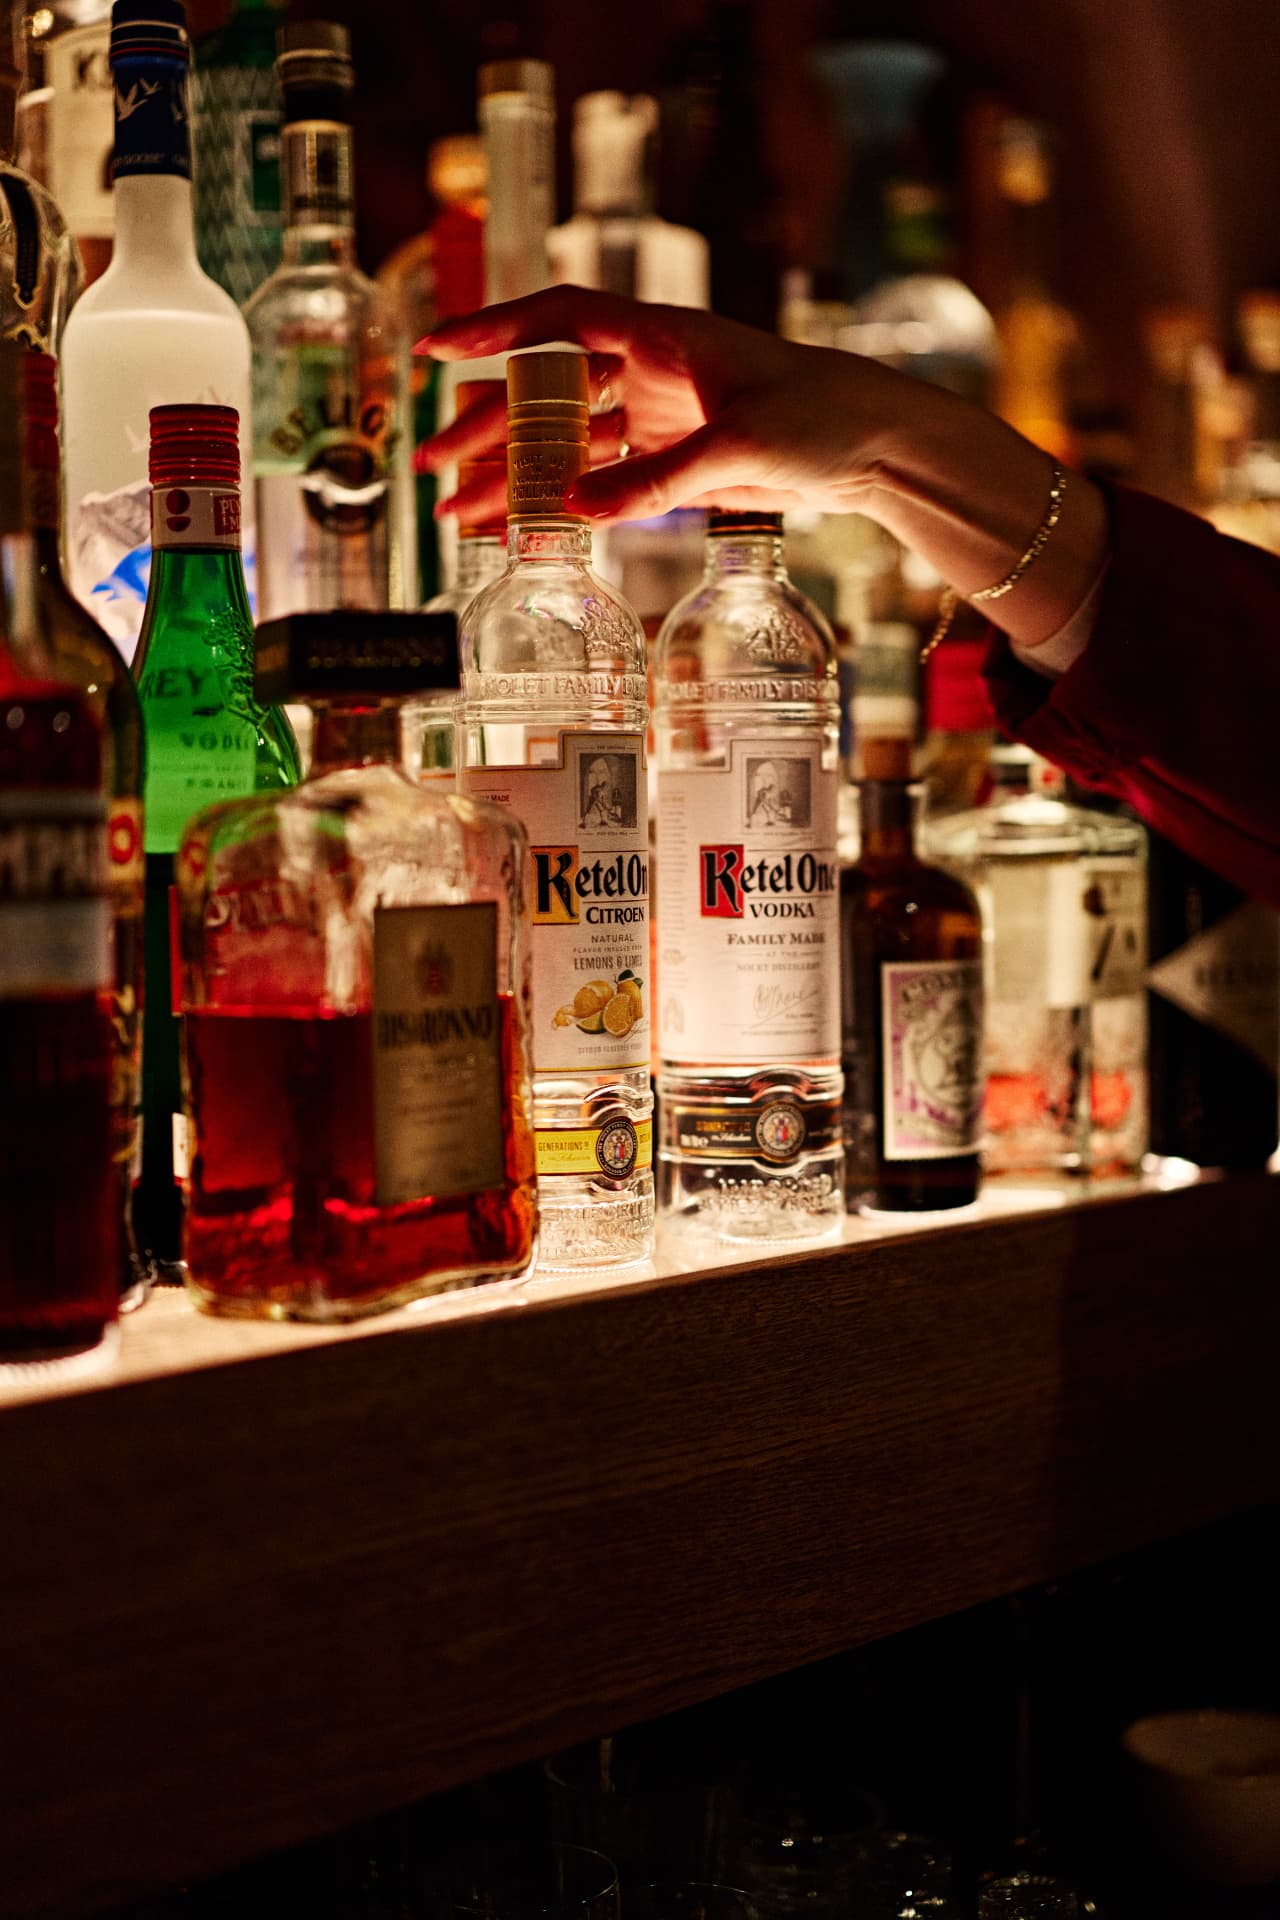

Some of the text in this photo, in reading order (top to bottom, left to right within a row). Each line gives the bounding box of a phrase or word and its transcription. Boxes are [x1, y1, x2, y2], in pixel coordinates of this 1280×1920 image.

[533, 851, 627, 919] Ketel
[702, 850, 795, 913] Ketel
[585, 905, 645, 925] CITROEN
[749, 902, 816, 919] VODKA
[591, 934, 635, 945] NATURAL
[727, 931, 825, 946] FAMILY MADE
[538, 1141, 583, 1152] GENERATIONS
